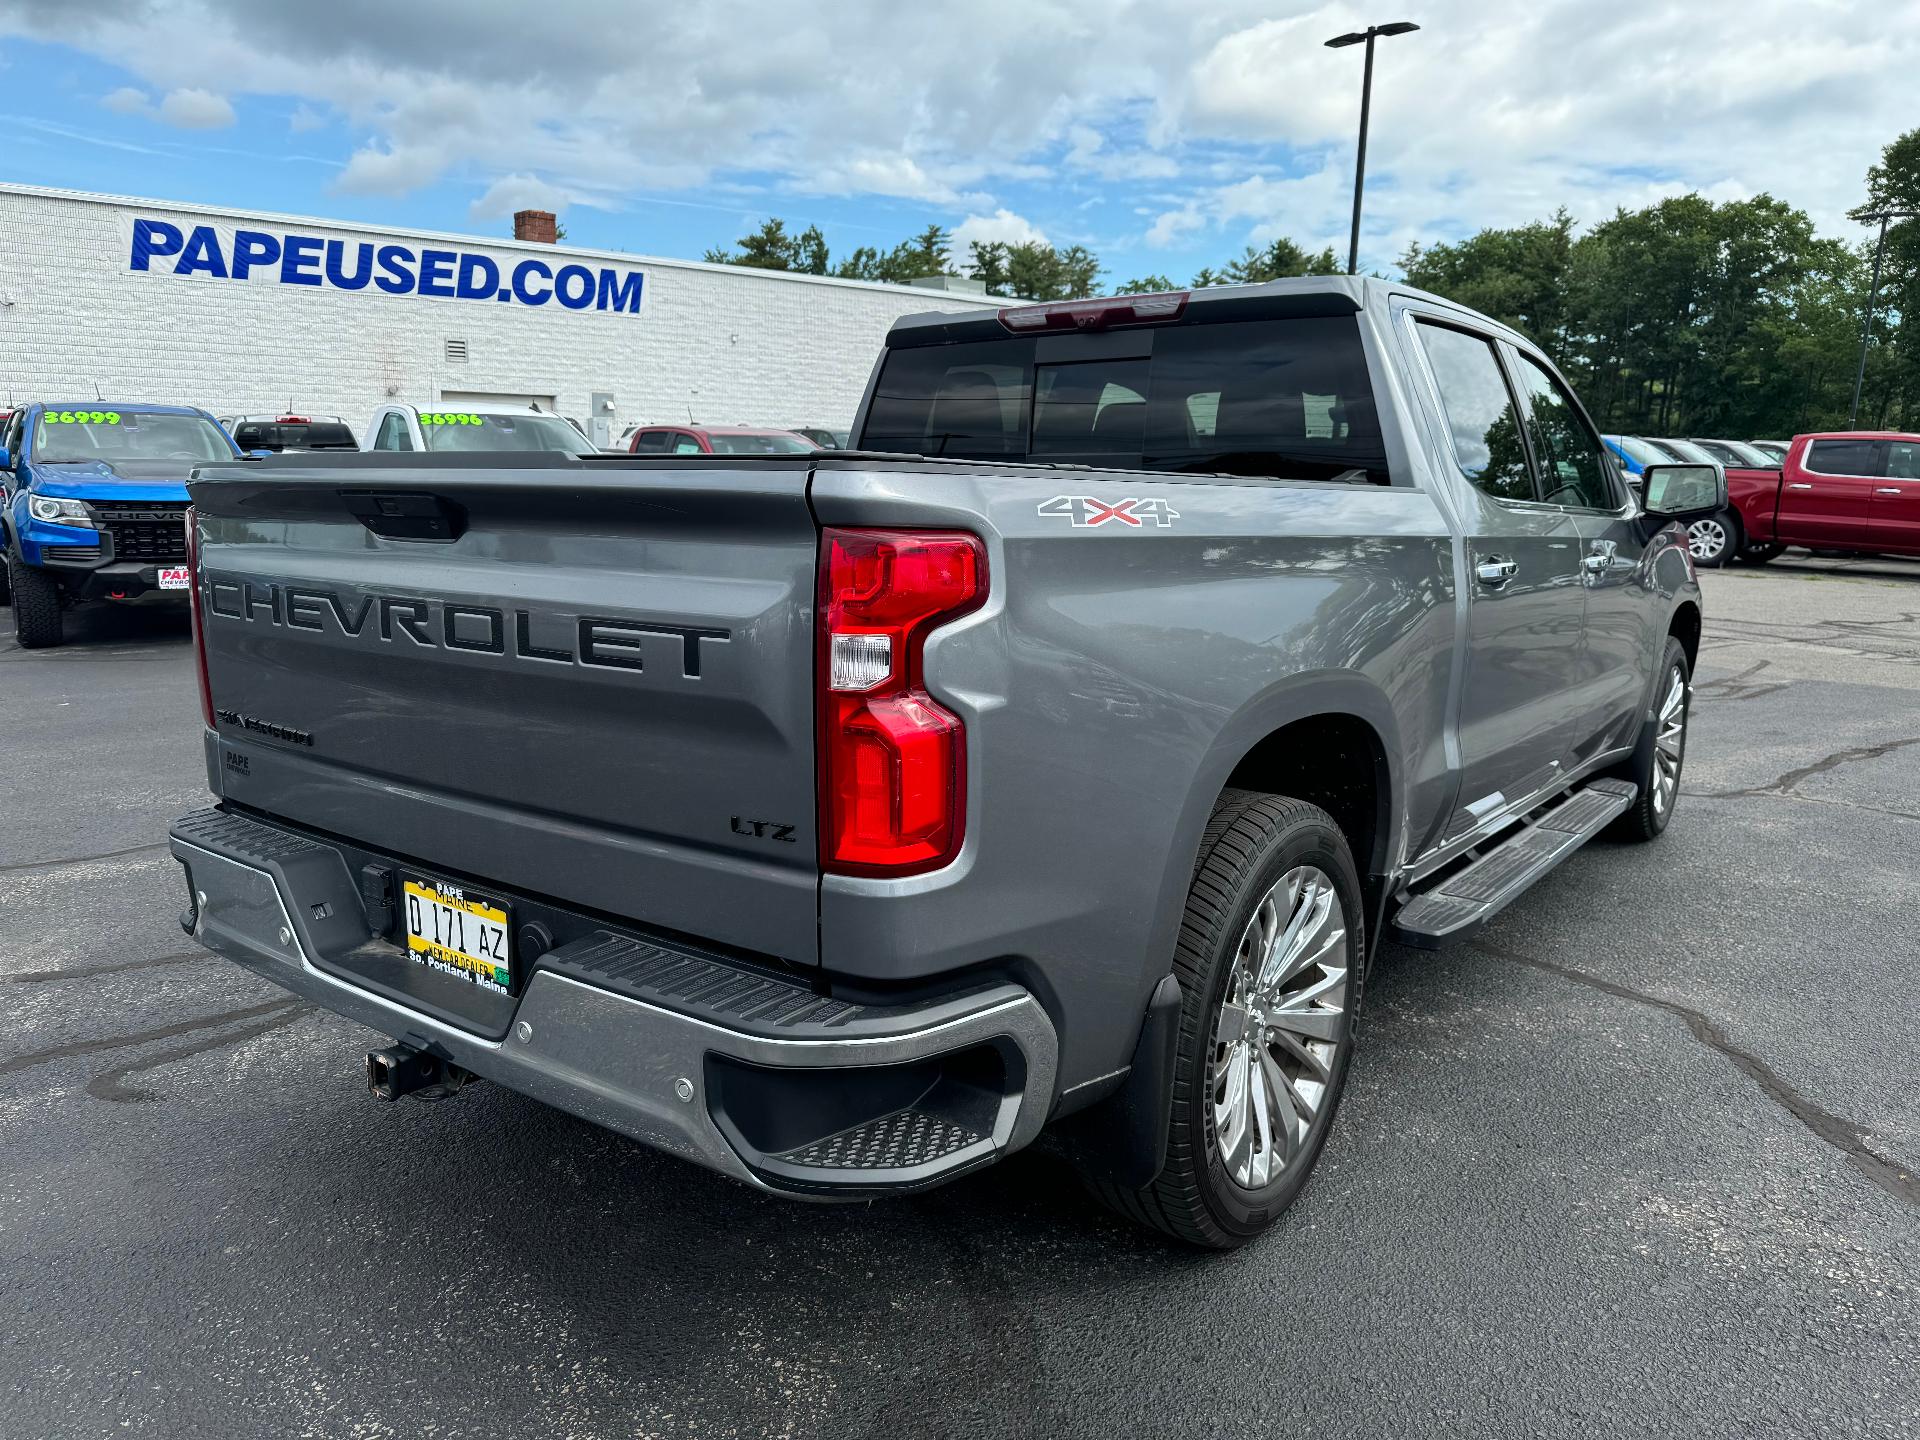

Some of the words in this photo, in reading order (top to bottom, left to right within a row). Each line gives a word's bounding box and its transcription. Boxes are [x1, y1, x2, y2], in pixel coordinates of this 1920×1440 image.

[130, 218, 642, 314] PAPEUSED.COM
[44, 411, 120, 425] 36999
[420, 413, 482, 426] 36996
[210, 579, 731, 680] CHEVROLET
[226, 751, 249, 769] PAPE
[731, 815, 796, 842] LTZ
[435, 893, 474, 913] MAINE
[436, 882, 464, 900] PAPE
[409, 894, 422, 936] D
[433, 903, 467, 954] 171
[479, 923, 505, 961] AZ
[409, 949, 425, 964] So.
[476, 972, 508, 995] Maine
[1204, 1015, 1219, 1150] MICHELIN
